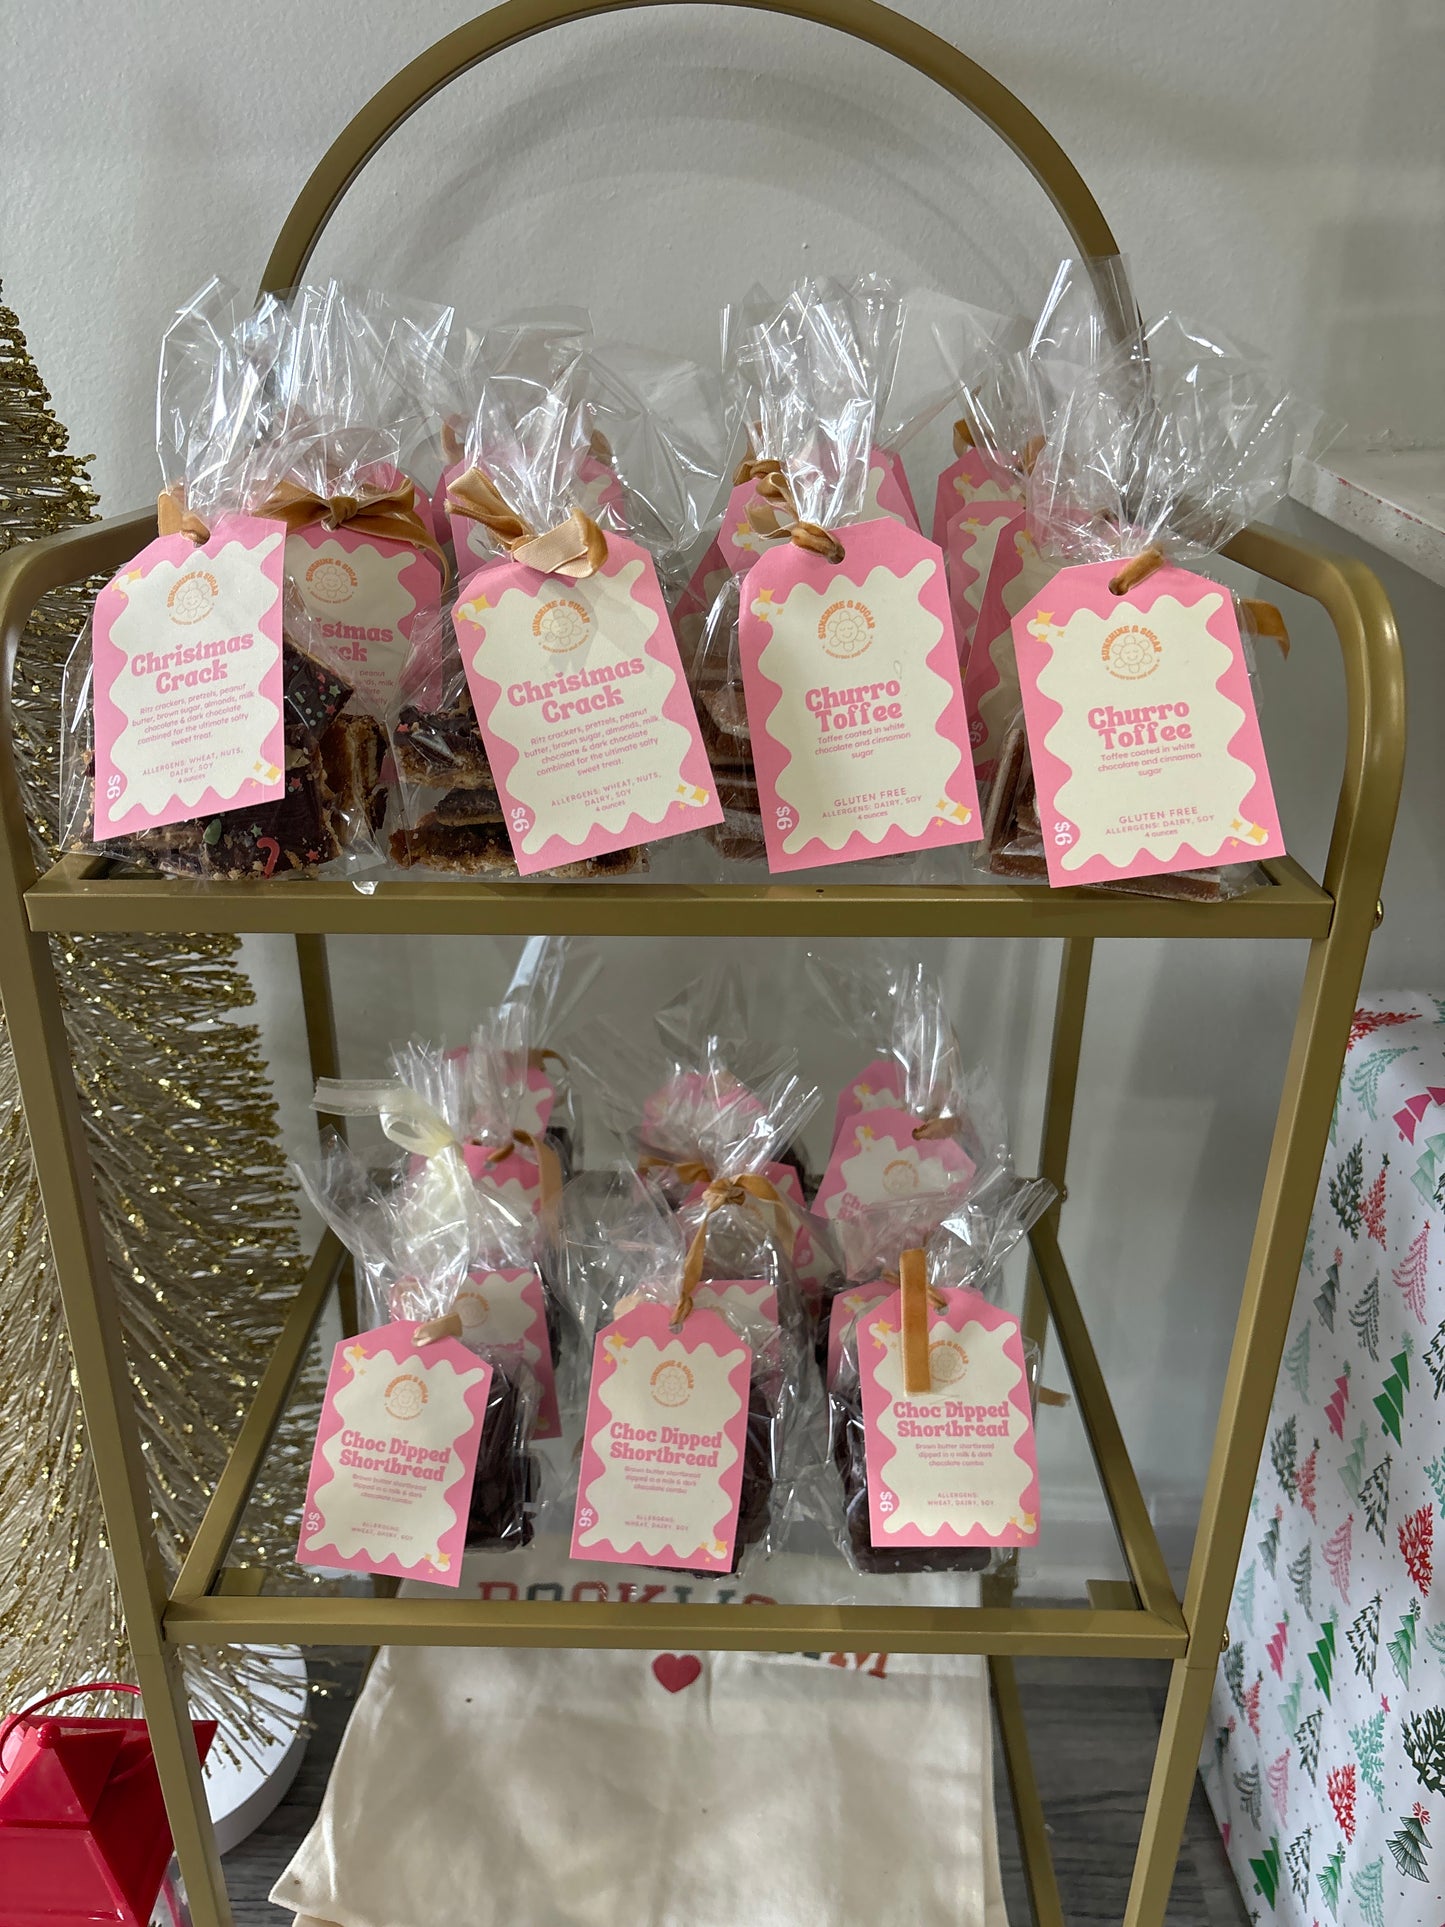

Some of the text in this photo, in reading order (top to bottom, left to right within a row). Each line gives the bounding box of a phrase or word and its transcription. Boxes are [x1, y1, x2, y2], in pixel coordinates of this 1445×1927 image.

[532, 600, 558, 637] SUNSHINE
[568, 601, 590, 624] SUGAR
[817, 601, 845, 639] SUNSHINE
[854, 602, 876, 629] SUGAR
[131, 633, 254, 677] Christmas
[1101, 626, 1130, 661] SUNSHINE
[1140, 628, 1162, 653] SUGAR
[156, 659, 228, 694] Crack
[507, 657, 645, 707] Christmas
[132, 689, 255, 728] butter, brown sugar, almonds, milk
[140, 683, 247, 716] Ritz crackers, pretzels, peanut
[542, 684, 624, 723] Crack
[805, 680, 901, 712] Churro
[144, 704, 242, 734] chocolate & dark chocolate
[530, 708, 648, 746] Ritz crackers, pretzels, peanut
[815, 702, 903, 733] Toffee
[1087, 701, 1190, 730] Churro
[137, 712, 249, 746] combined for the ultimate salty
[171, 731, 213, 747] sweet treat.
[523, 715, 660, 759] butter, brown sugar, almonds, milk
[817, 722, 905, 745] Toffee coated in white
[1098, 722, 1193, 750] Toffee
[541, 729, 649, 765] chocolate & dark chocolate
[814, 731, 911, 756] chocolate and cinnamon
[851, 749, 874, 760] sugar
[1100, 742, 1196, 762] Toffee coated in white
[198, 762, 214, 771] SOY
[536, 737, 660, 777] combined for the ultimate salty
[577, 759, 625, 777] sweet treat.
[1097, 751, 1202, 773] chocolate and cinnamon
[602, 779, 635, 794] WHEAT,
[636, 772, 663, 784] NUTS,
[1138, 767, 1163, 777] sugar
[584, 789, 632, 808] DAIRY, SOY
[601, 800, 626, 812] ounces
[821, 795, 922, 819] ALLERGENS: DAIRY, SOY
[833, 787, 907, 808] GLUTEN FREE
[510, 806, 530, 833] $6
[775, 806, 793, 831] $6
[863, 810, 889, 820] ounces
[1104, 814, 1215, 836] ALLERGENS: DAIRY, SOY
[1118, 806, 1198, 825] GLUTEN FREE
[1053, 821, 1073, 847] $6
[1151, 828, 1179, 838] ounces
[893, 1400, 1010, 1422] Choc Dipped
[610, 1421, 723, 1451] Choc Dipped
[897, 1419, 1010, 1437] Shortbread
[340, 1429, 452, 1464] Choc Dipped
[609, 1441, 719, 1468] Shortbread
[339, 1448, 446, 1482] Shortbread
[879, 1491, 894, 1513] $6
[305, 1511, 321, 1532] $6
[578, 1507, 594, 1528] $6
